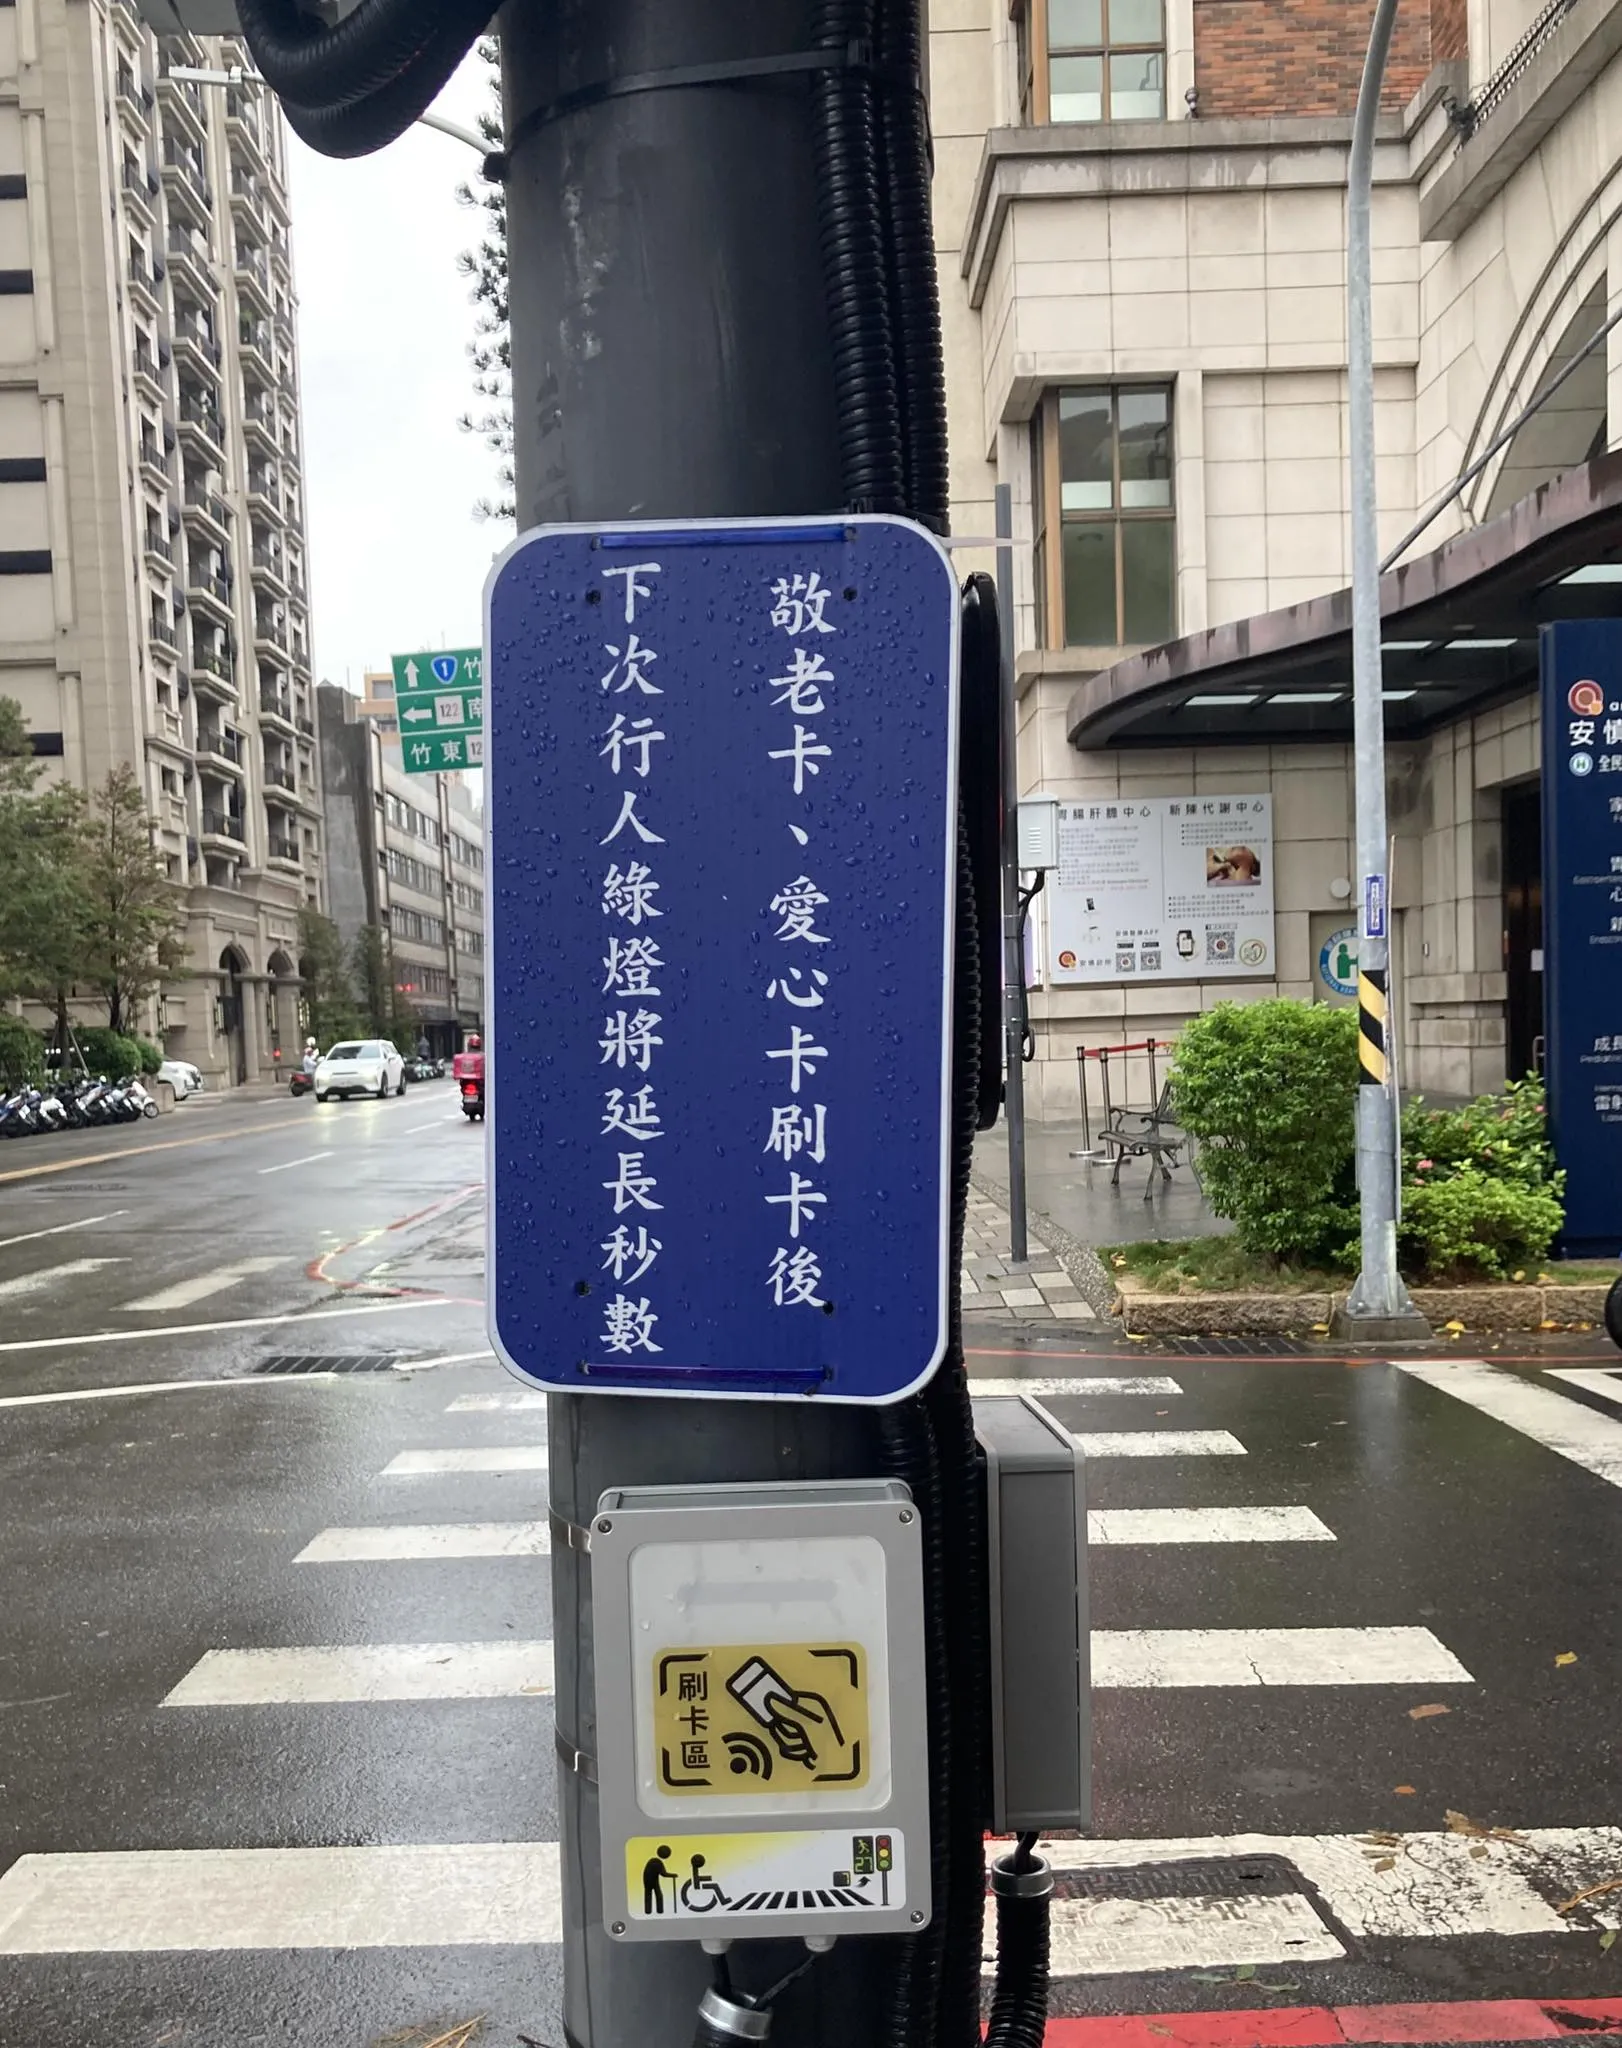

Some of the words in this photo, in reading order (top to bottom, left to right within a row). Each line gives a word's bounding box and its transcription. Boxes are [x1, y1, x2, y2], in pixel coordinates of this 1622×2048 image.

[411, 740, 462, 765] 竹東
[1169, 801, 1264, 816] 新陳代謝中心
[598, 562, 666, 1354] 下次行人綠燈將延長秒數
[763, 572, 837, 1307] 敬老卡、愛心卡刷卡後
[678, 1670, 711, 1769] 刷卡區
